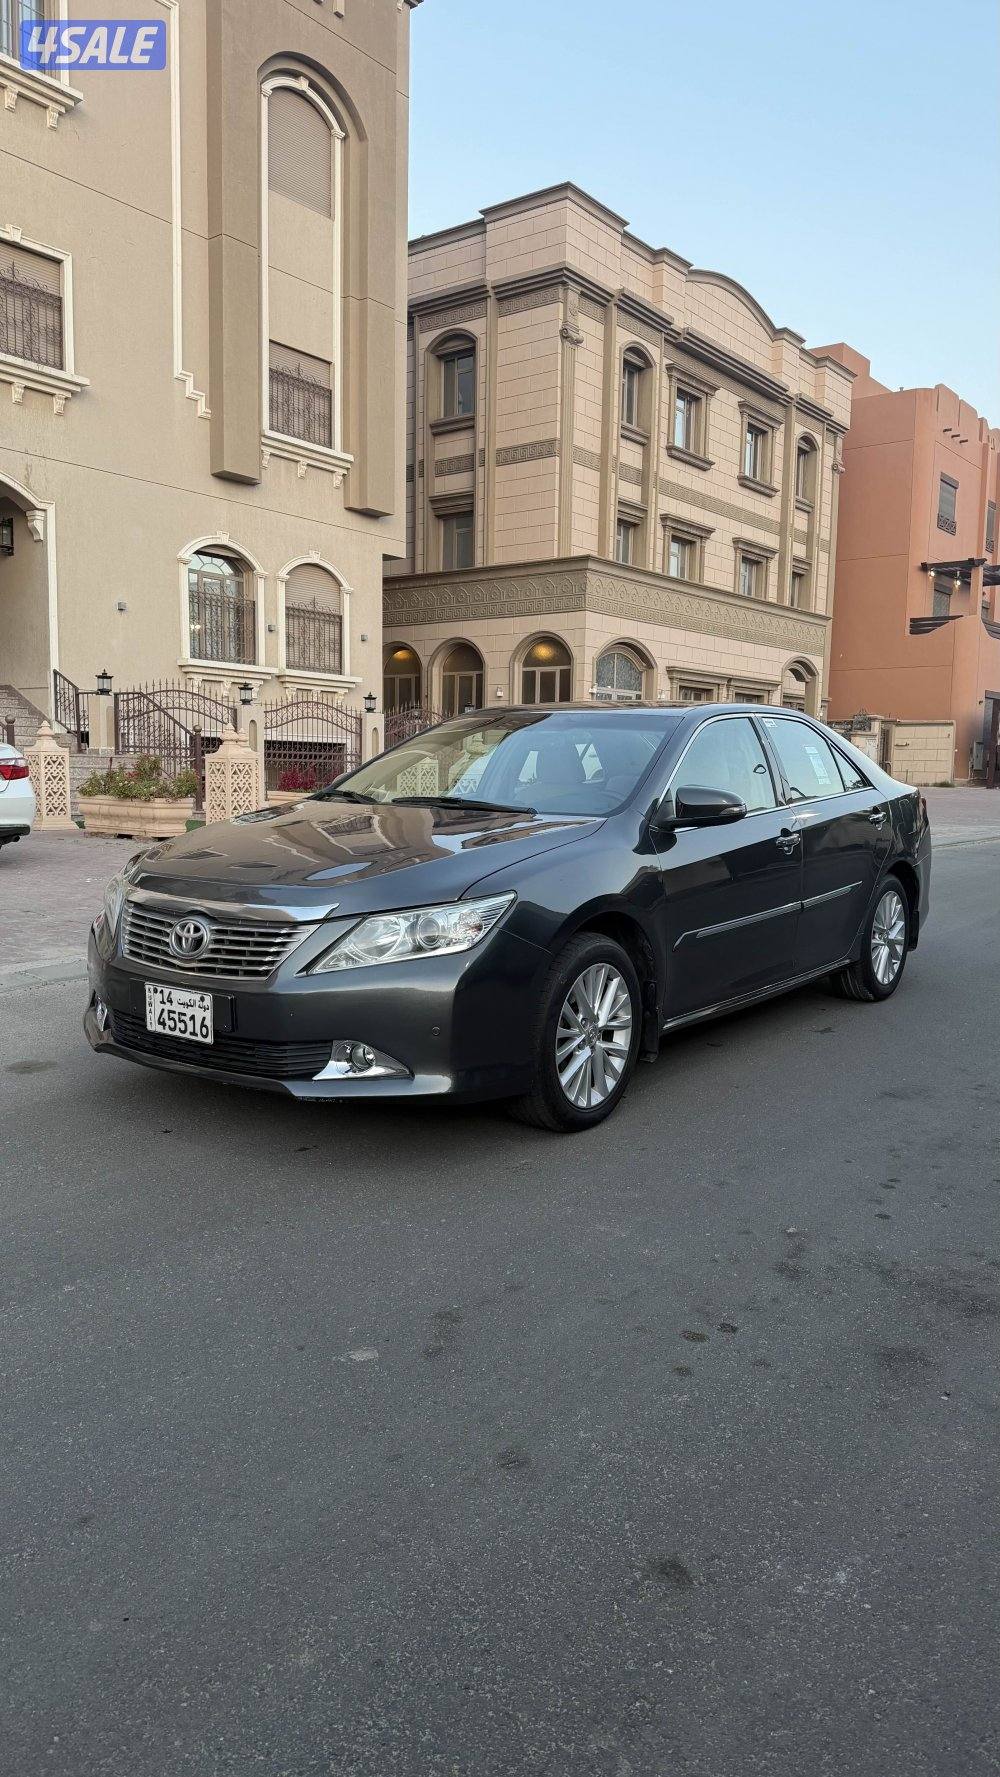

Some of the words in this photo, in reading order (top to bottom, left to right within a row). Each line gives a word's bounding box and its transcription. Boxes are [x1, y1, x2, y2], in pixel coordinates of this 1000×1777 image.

[159, 989, 173, 1006] 14
[177, 998, 196, 1009] الكويت
[157, 1008, 209, 1039] 45516
